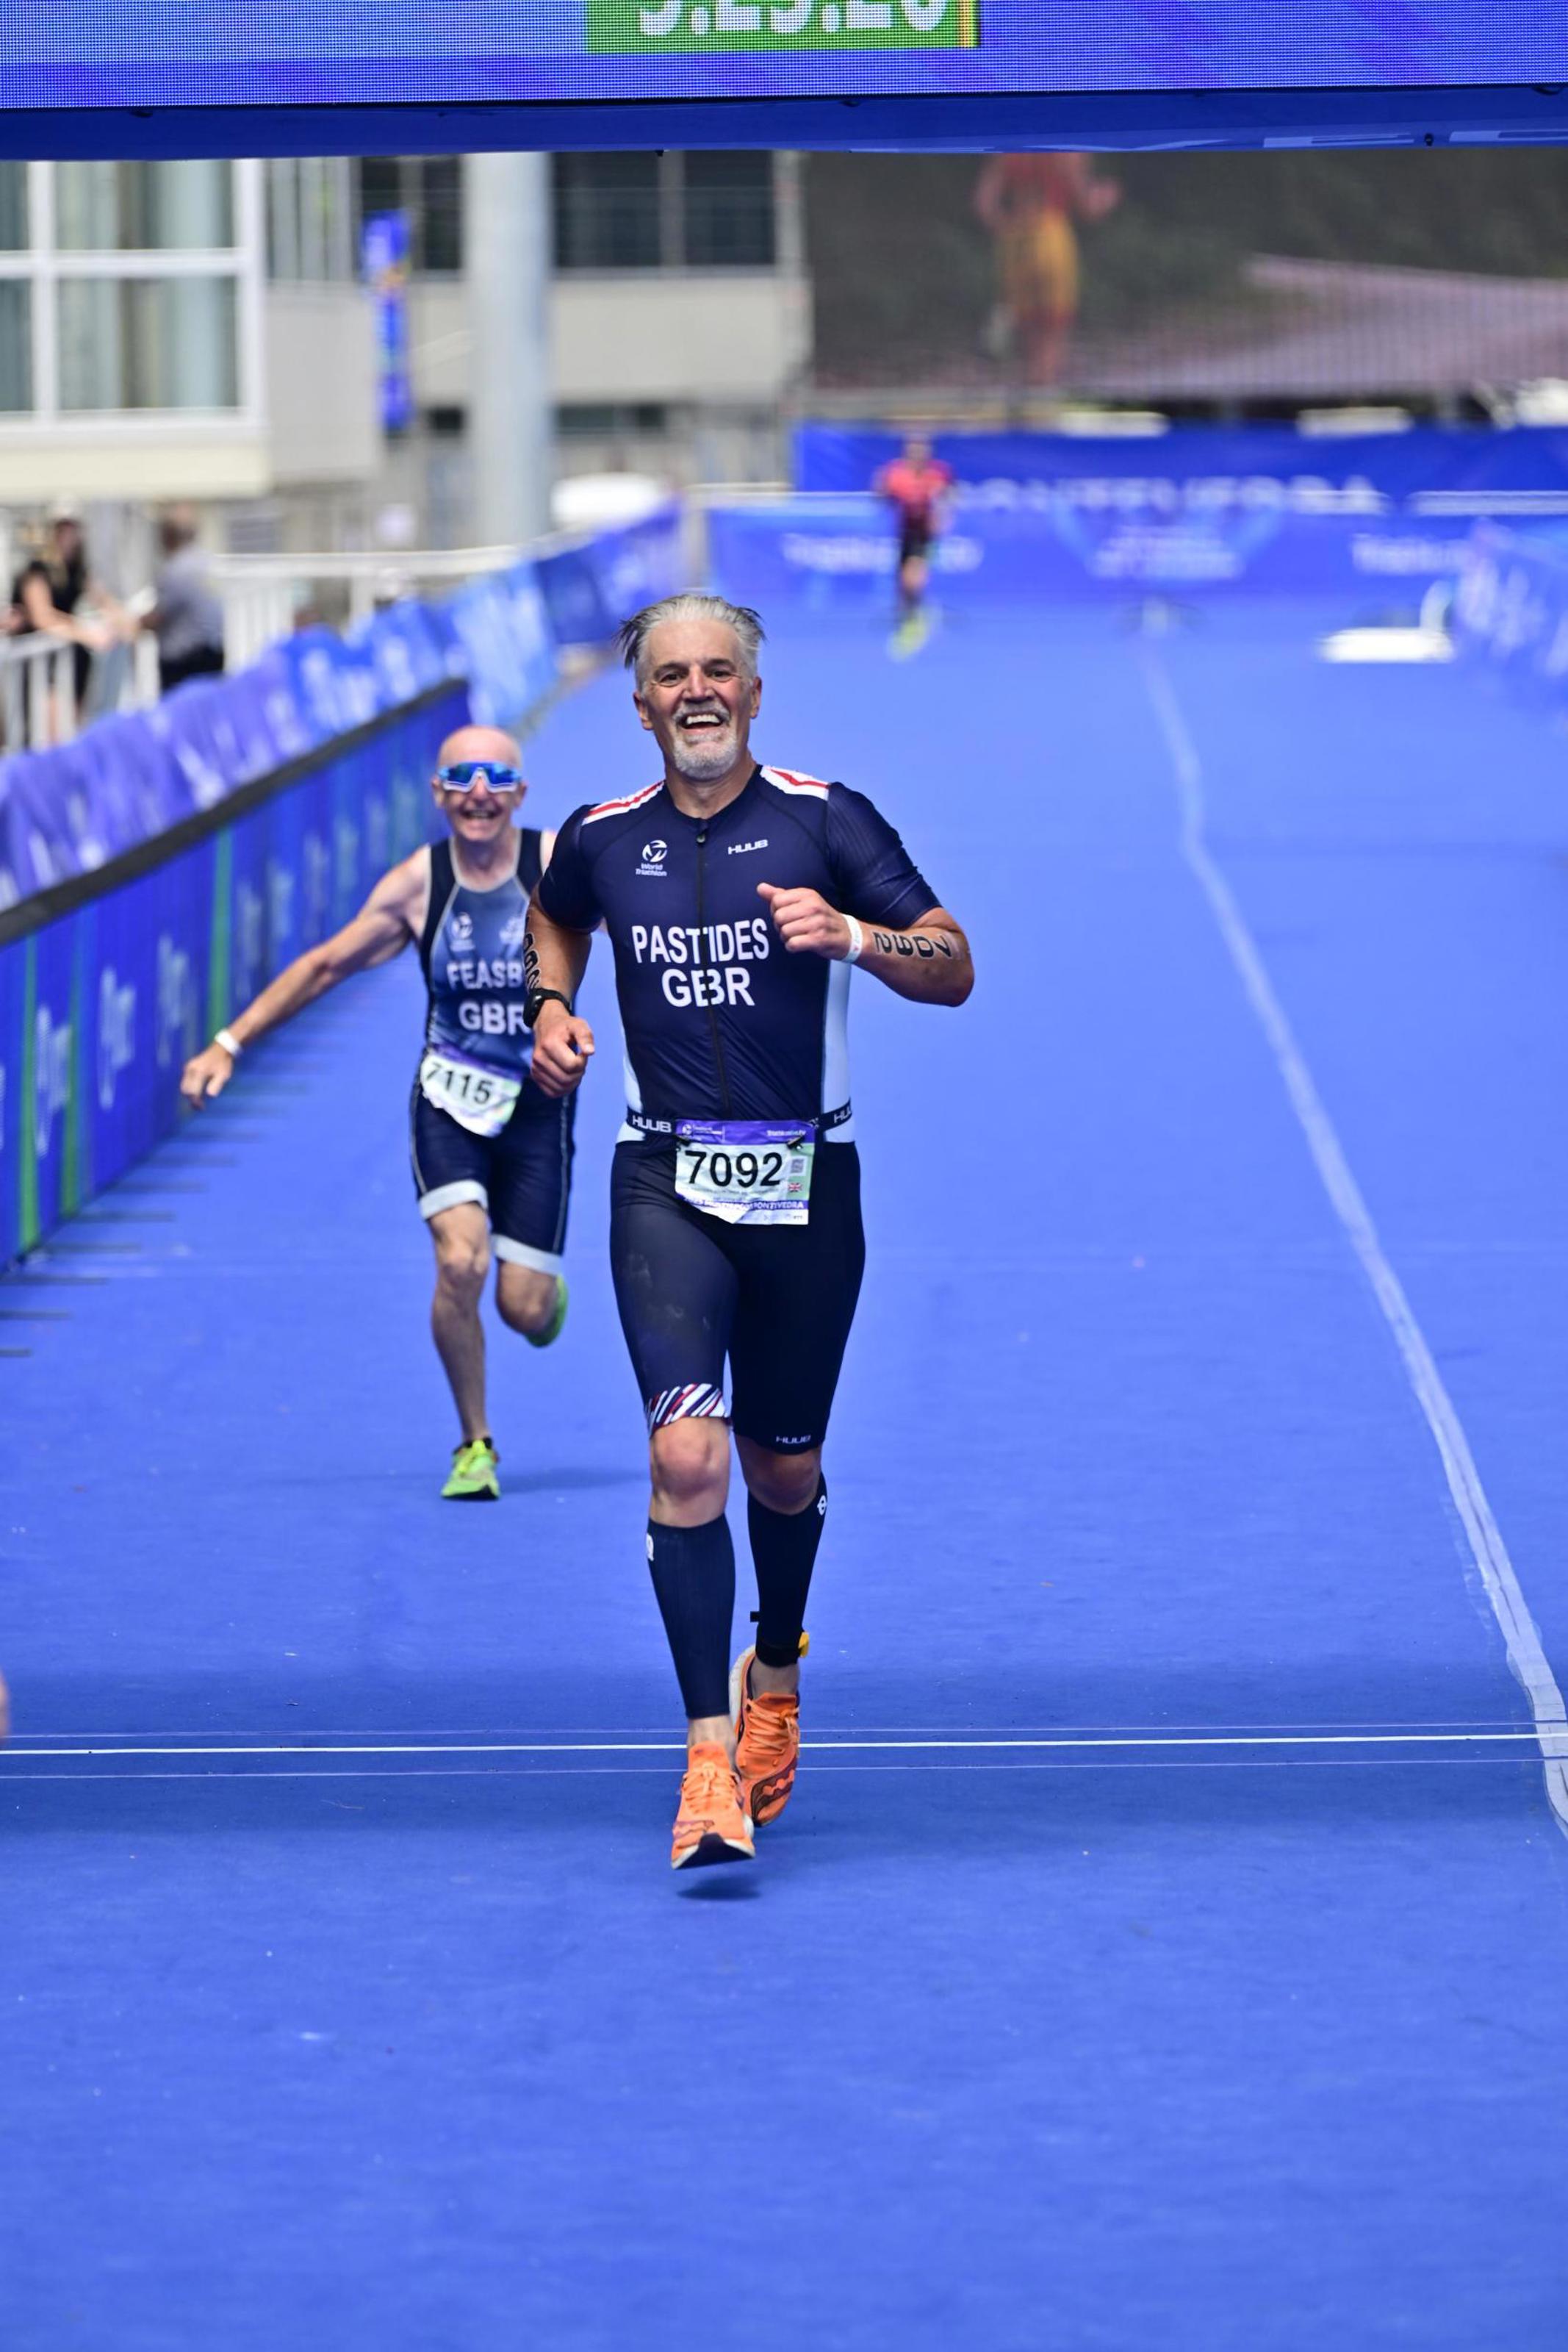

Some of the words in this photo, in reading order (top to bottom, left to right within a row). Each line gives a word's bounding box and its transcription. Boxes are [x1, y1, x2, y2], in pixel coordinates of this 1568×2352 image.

[727, 839, 769, 854] HUUB
[631, 918, 769, 964] PASTIDES
[446, 958, 525, 991] FEASB
[662, 967, 755, 1008] GBR
[458, 1000, 531, 1036] GBR
[426, 1063, 495, 1105] 7115
[632, 1114, 672, 1133] HUUB
[833, 1106, 851, 1124] HU
[685, 1150, 783, 1188] 7092
